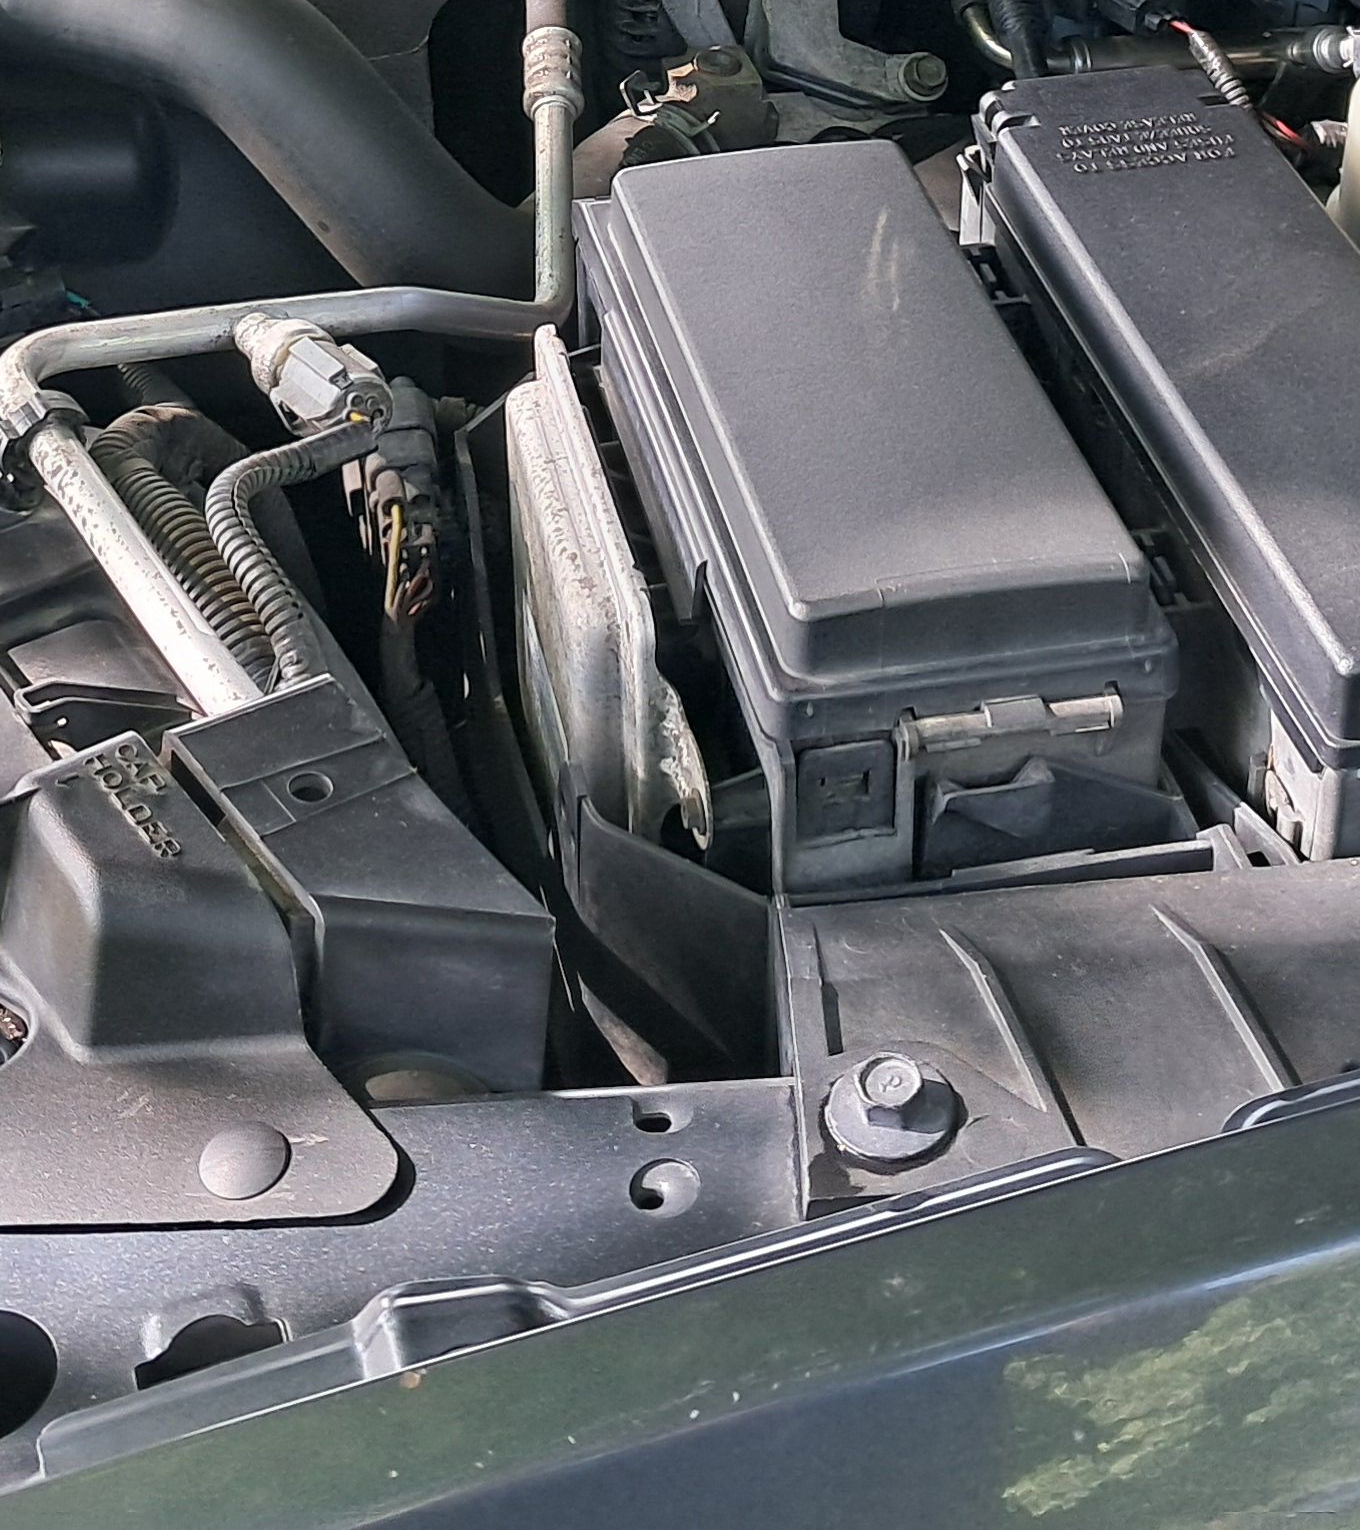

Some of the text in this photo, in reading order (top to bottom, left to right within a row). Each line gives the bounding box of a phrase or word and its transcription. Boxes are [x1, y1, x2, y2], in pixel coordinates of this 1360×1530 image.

[1059, 121, 1117, 136] COVER
[1061, 137, 1081, 149] TO
[1133, 141, 1168, 154] AND
[1193, 147, 1235, 161] FOR
[1073, 161, 1098, 173] TO
[115, 743, 167, 795] CAP
[83, 753, 182, 859] HOLDER
